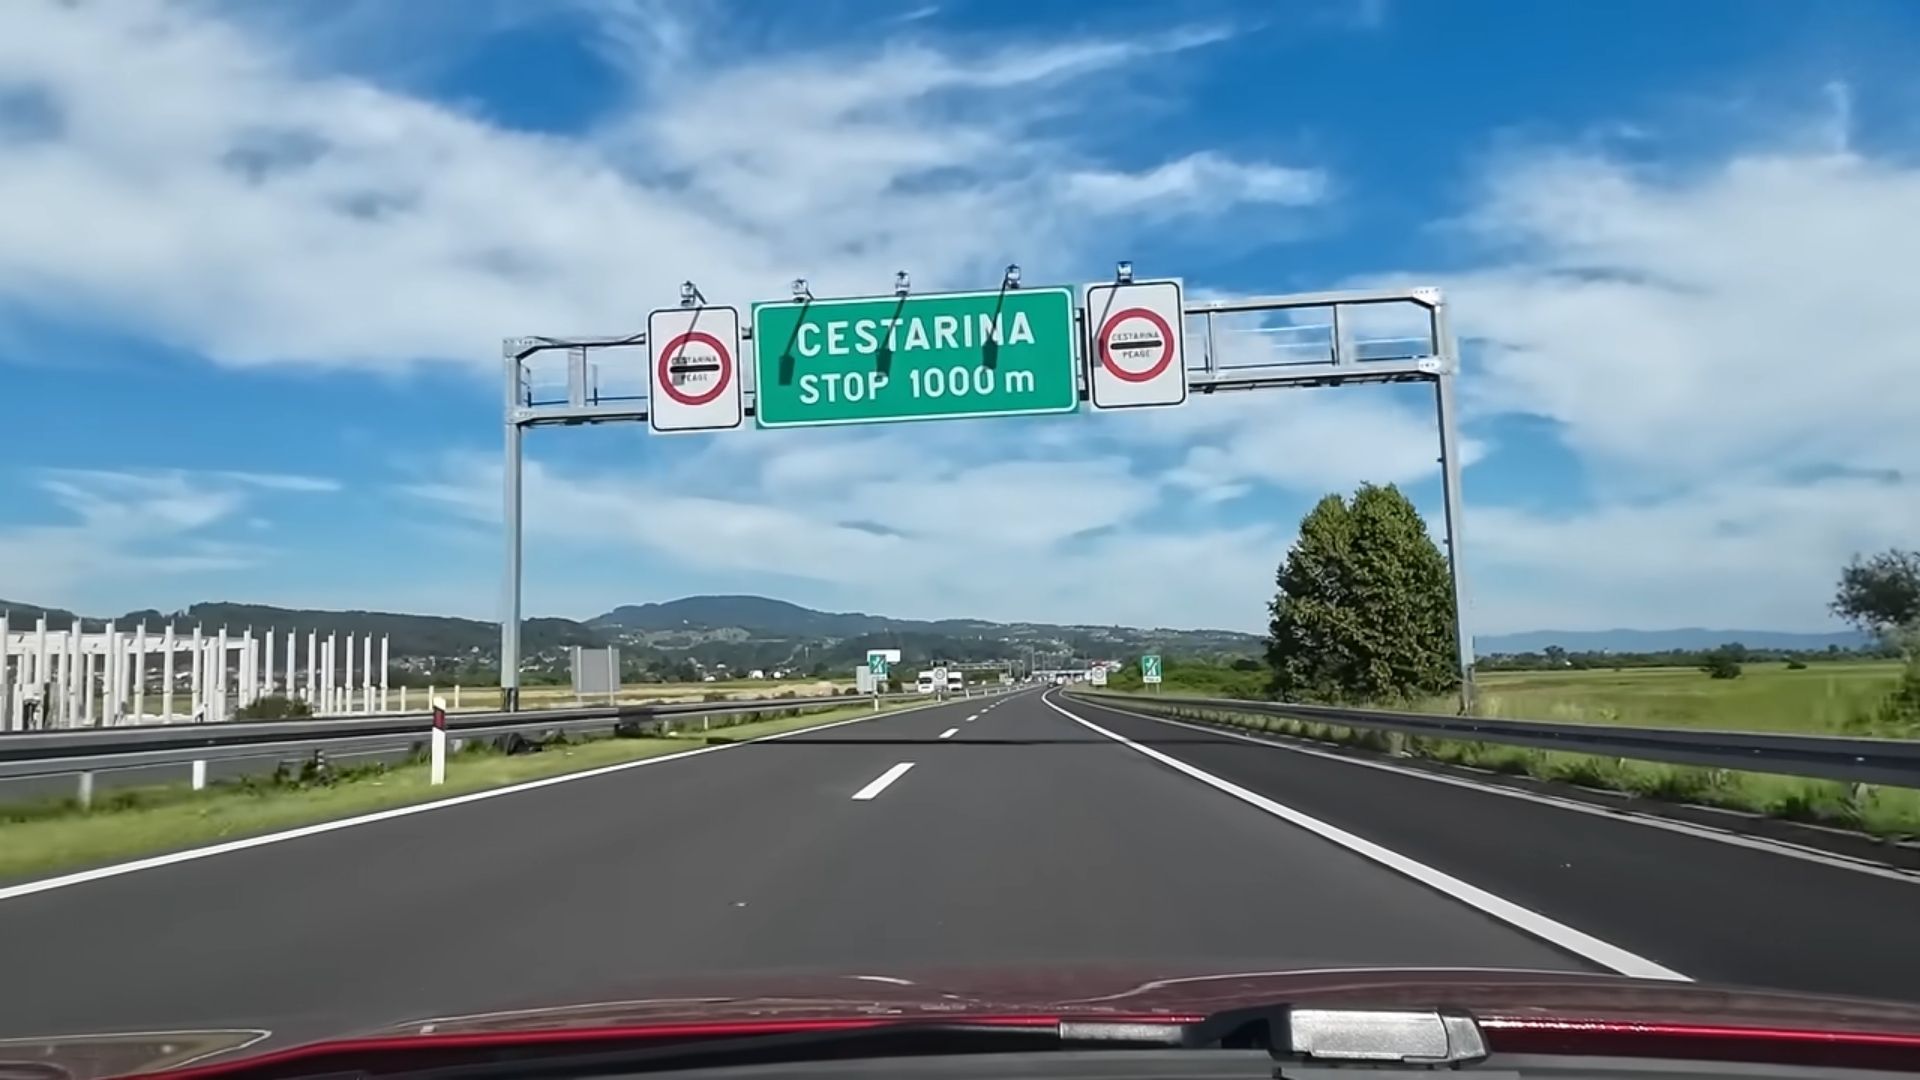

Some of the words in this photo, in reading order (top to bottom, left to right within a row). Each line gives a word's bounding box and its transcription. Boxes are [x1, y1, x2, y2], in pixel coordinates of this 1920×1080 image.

[797, 311, 1035, 357] CESTARINA
[799, 371, 889, 404] STOP
[910, 366, 995, 397] 1000
[1004, 369, 1034, 392] m
